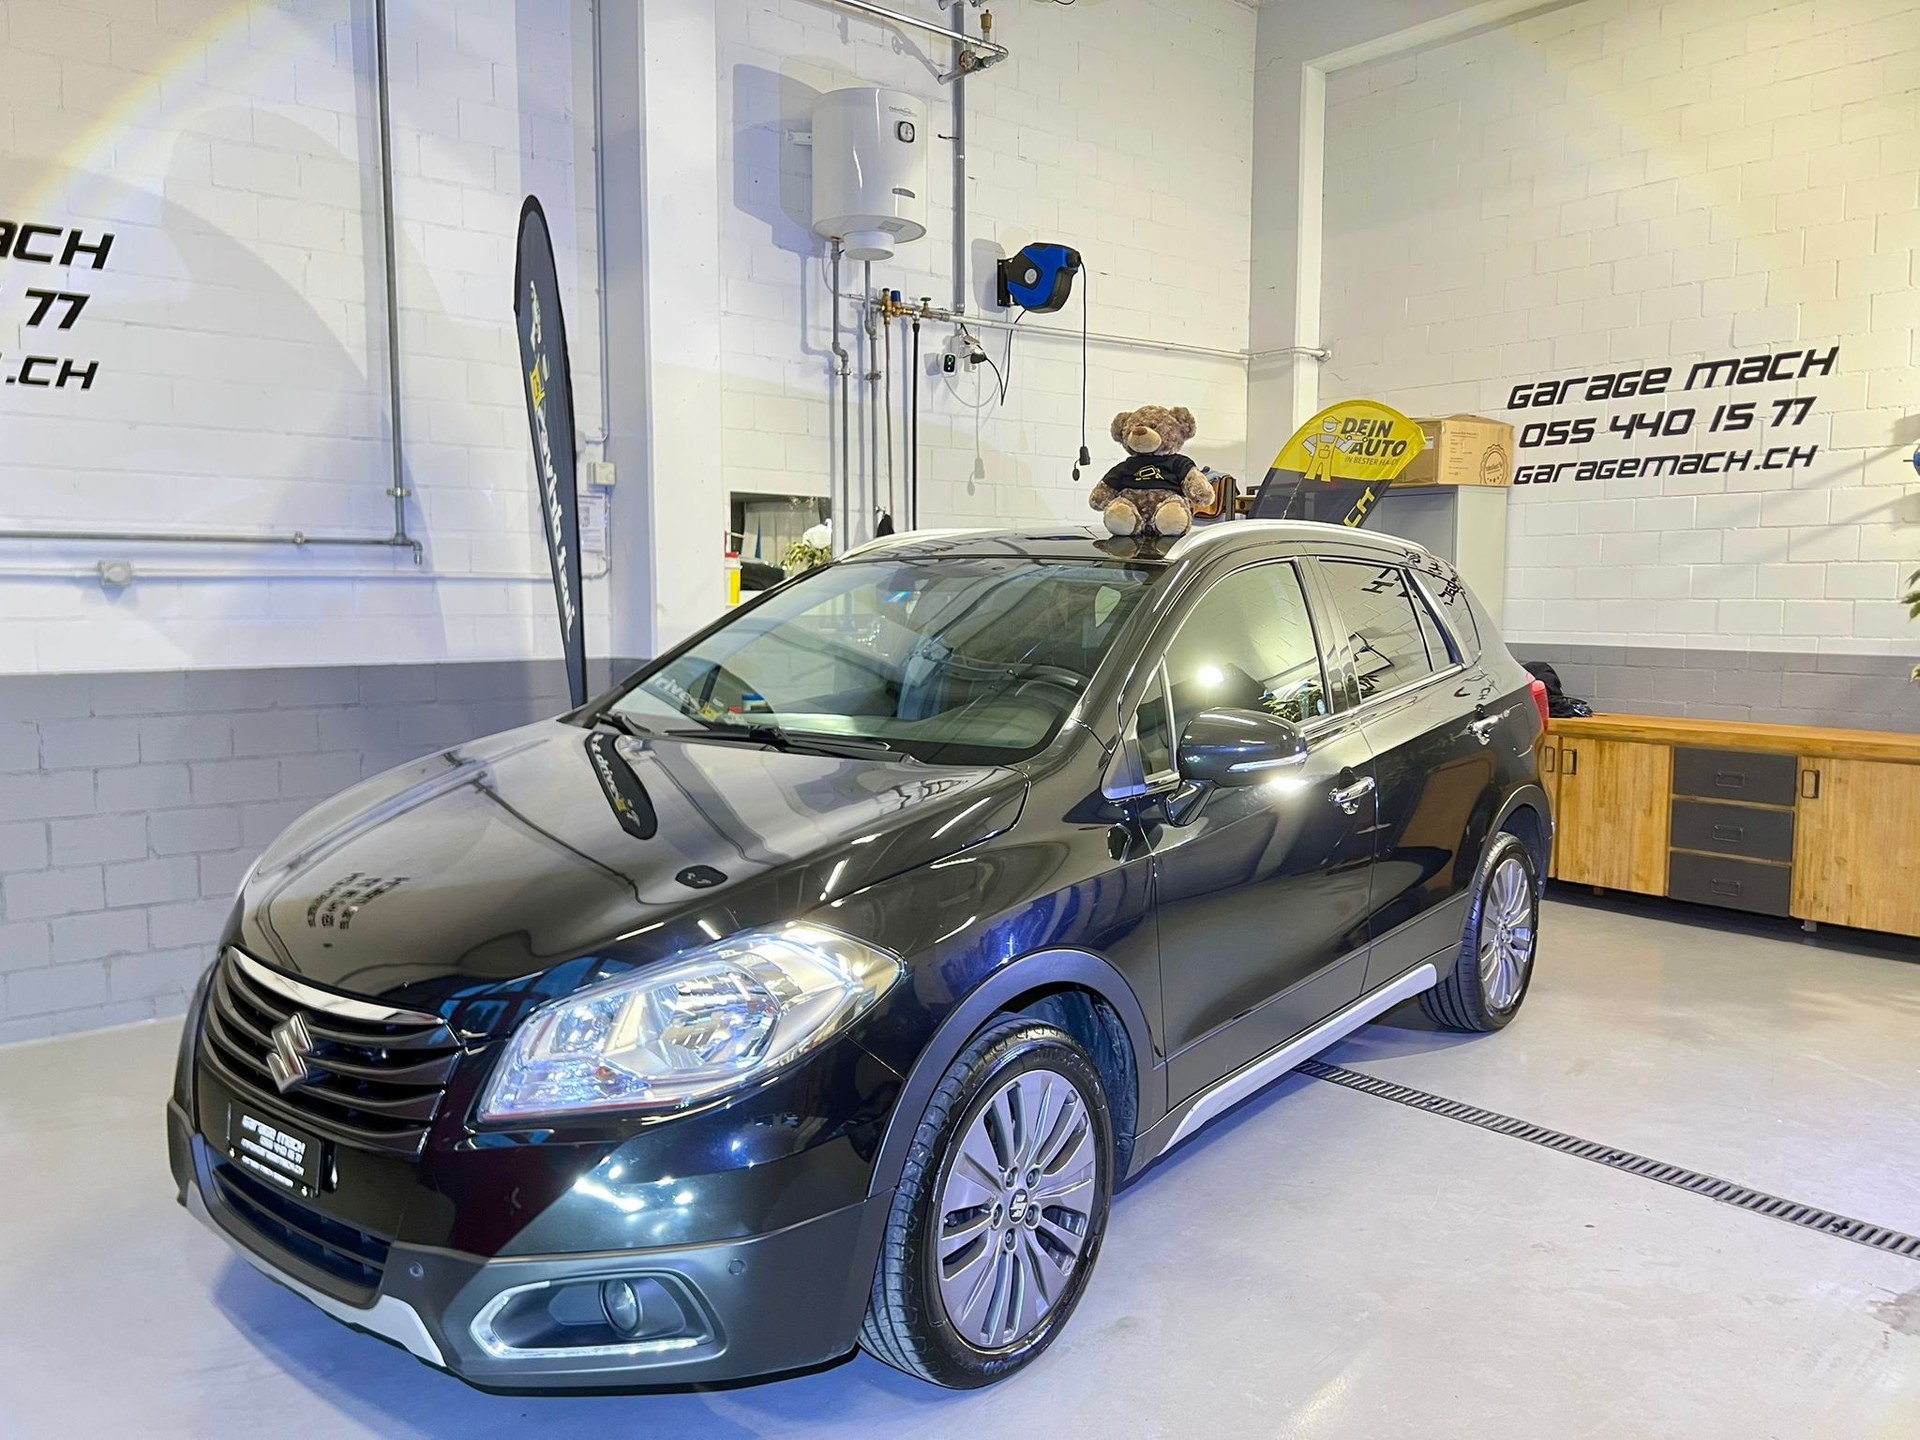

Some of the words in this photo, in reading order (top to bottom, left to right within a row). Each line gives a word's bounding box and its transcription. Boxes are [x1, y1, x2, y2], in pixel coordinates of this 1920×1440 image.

[25, 288, 90, 330] 77
[1341, 417, 1394, 438] DEIN
[1518, 417, 1597, 448] 055
[1608, 408, 1696, 440] 440
[1708, 401, 1757, 433] 15
[1770, 395, 1818, 428] 77
[1349, 439, 1407, 457] AUTO
